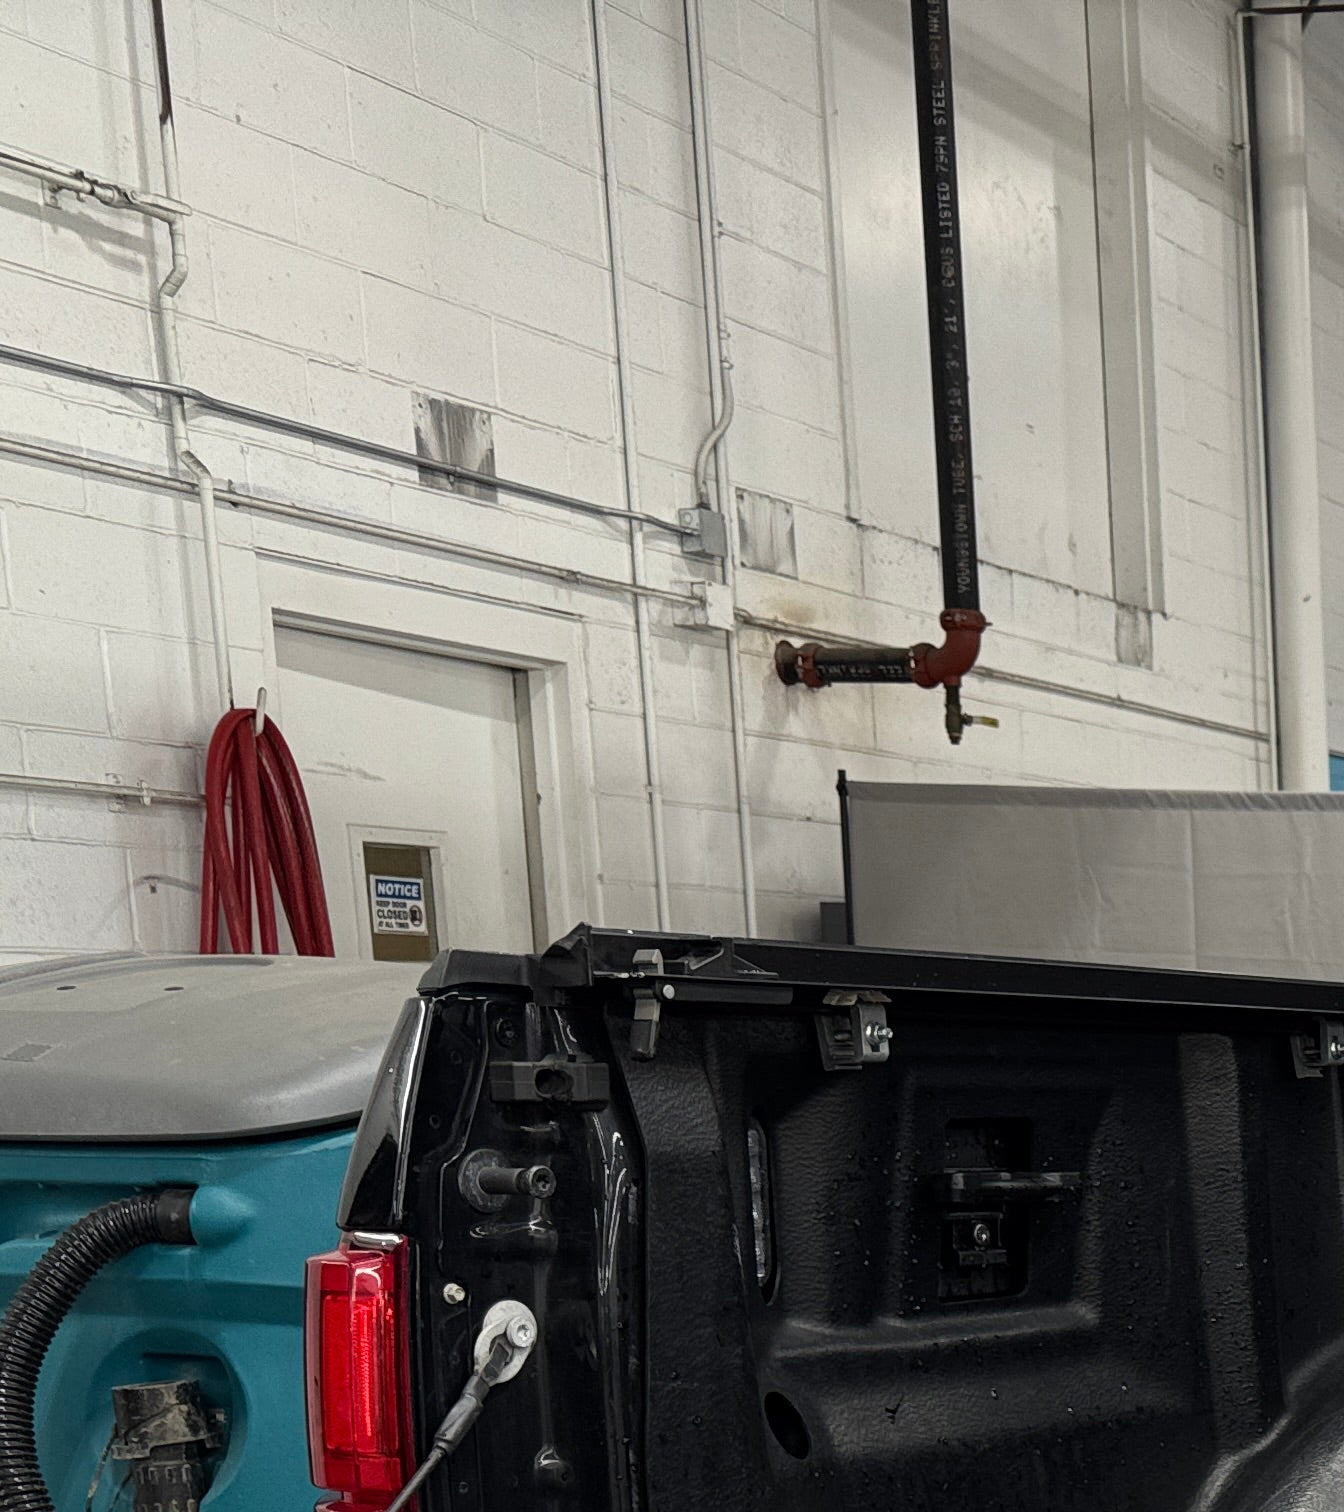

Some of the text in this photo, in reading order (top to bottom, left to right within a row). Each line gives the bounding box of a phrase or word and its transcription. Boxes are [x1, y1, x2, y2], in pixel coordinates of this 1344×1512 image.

[932, 79, 947, 126] STEEL
[937, 181, 953, 238] LISTED
[377, 882, 419, 898] NOTICE
[377, 909, 408, 920] CLOSED
